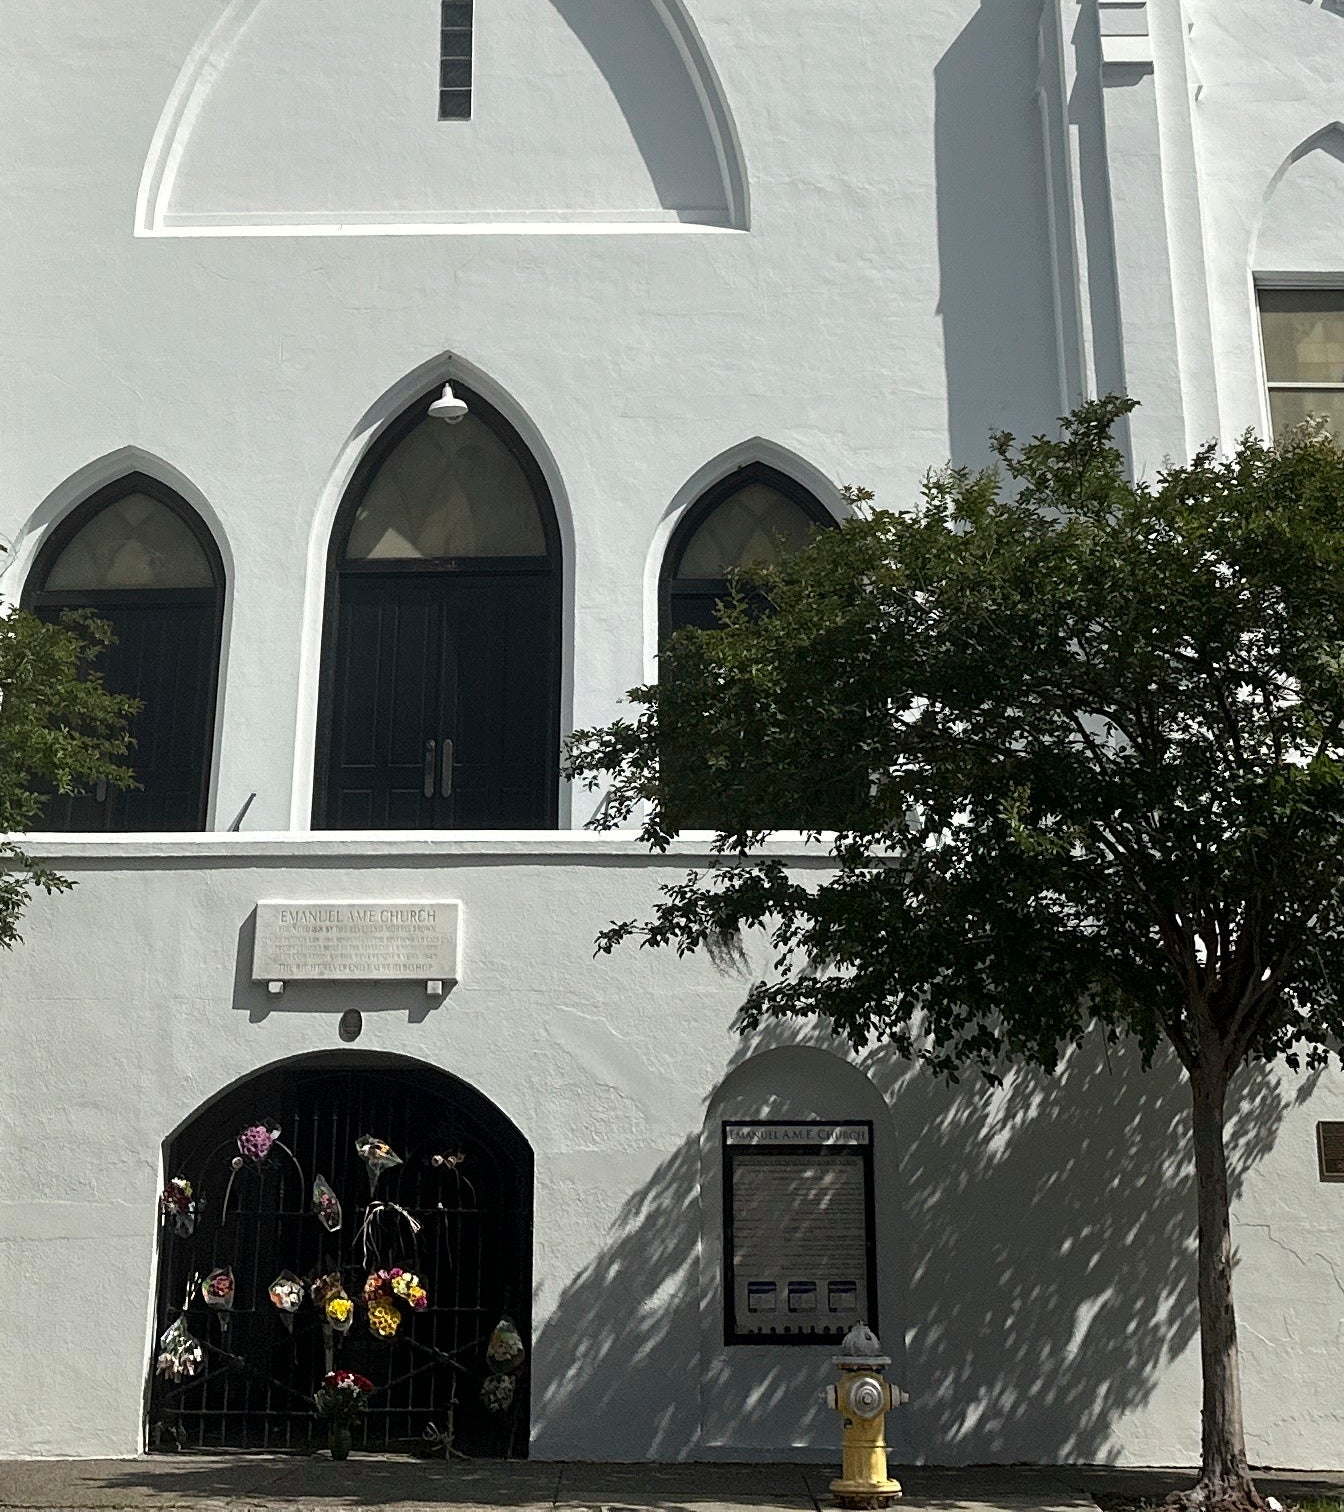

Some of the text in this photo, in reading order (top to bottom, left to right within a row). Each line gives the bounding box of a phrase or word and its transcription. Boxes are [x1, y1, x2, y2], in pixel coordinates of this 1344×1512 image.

[280, 909, 343, 923] EMANUEL
[380, 909, 436, 923] CHURCH
[728, 1128, 779, 1140] EMANUEL
[817, 1128, 865, 1140] CHURCH
